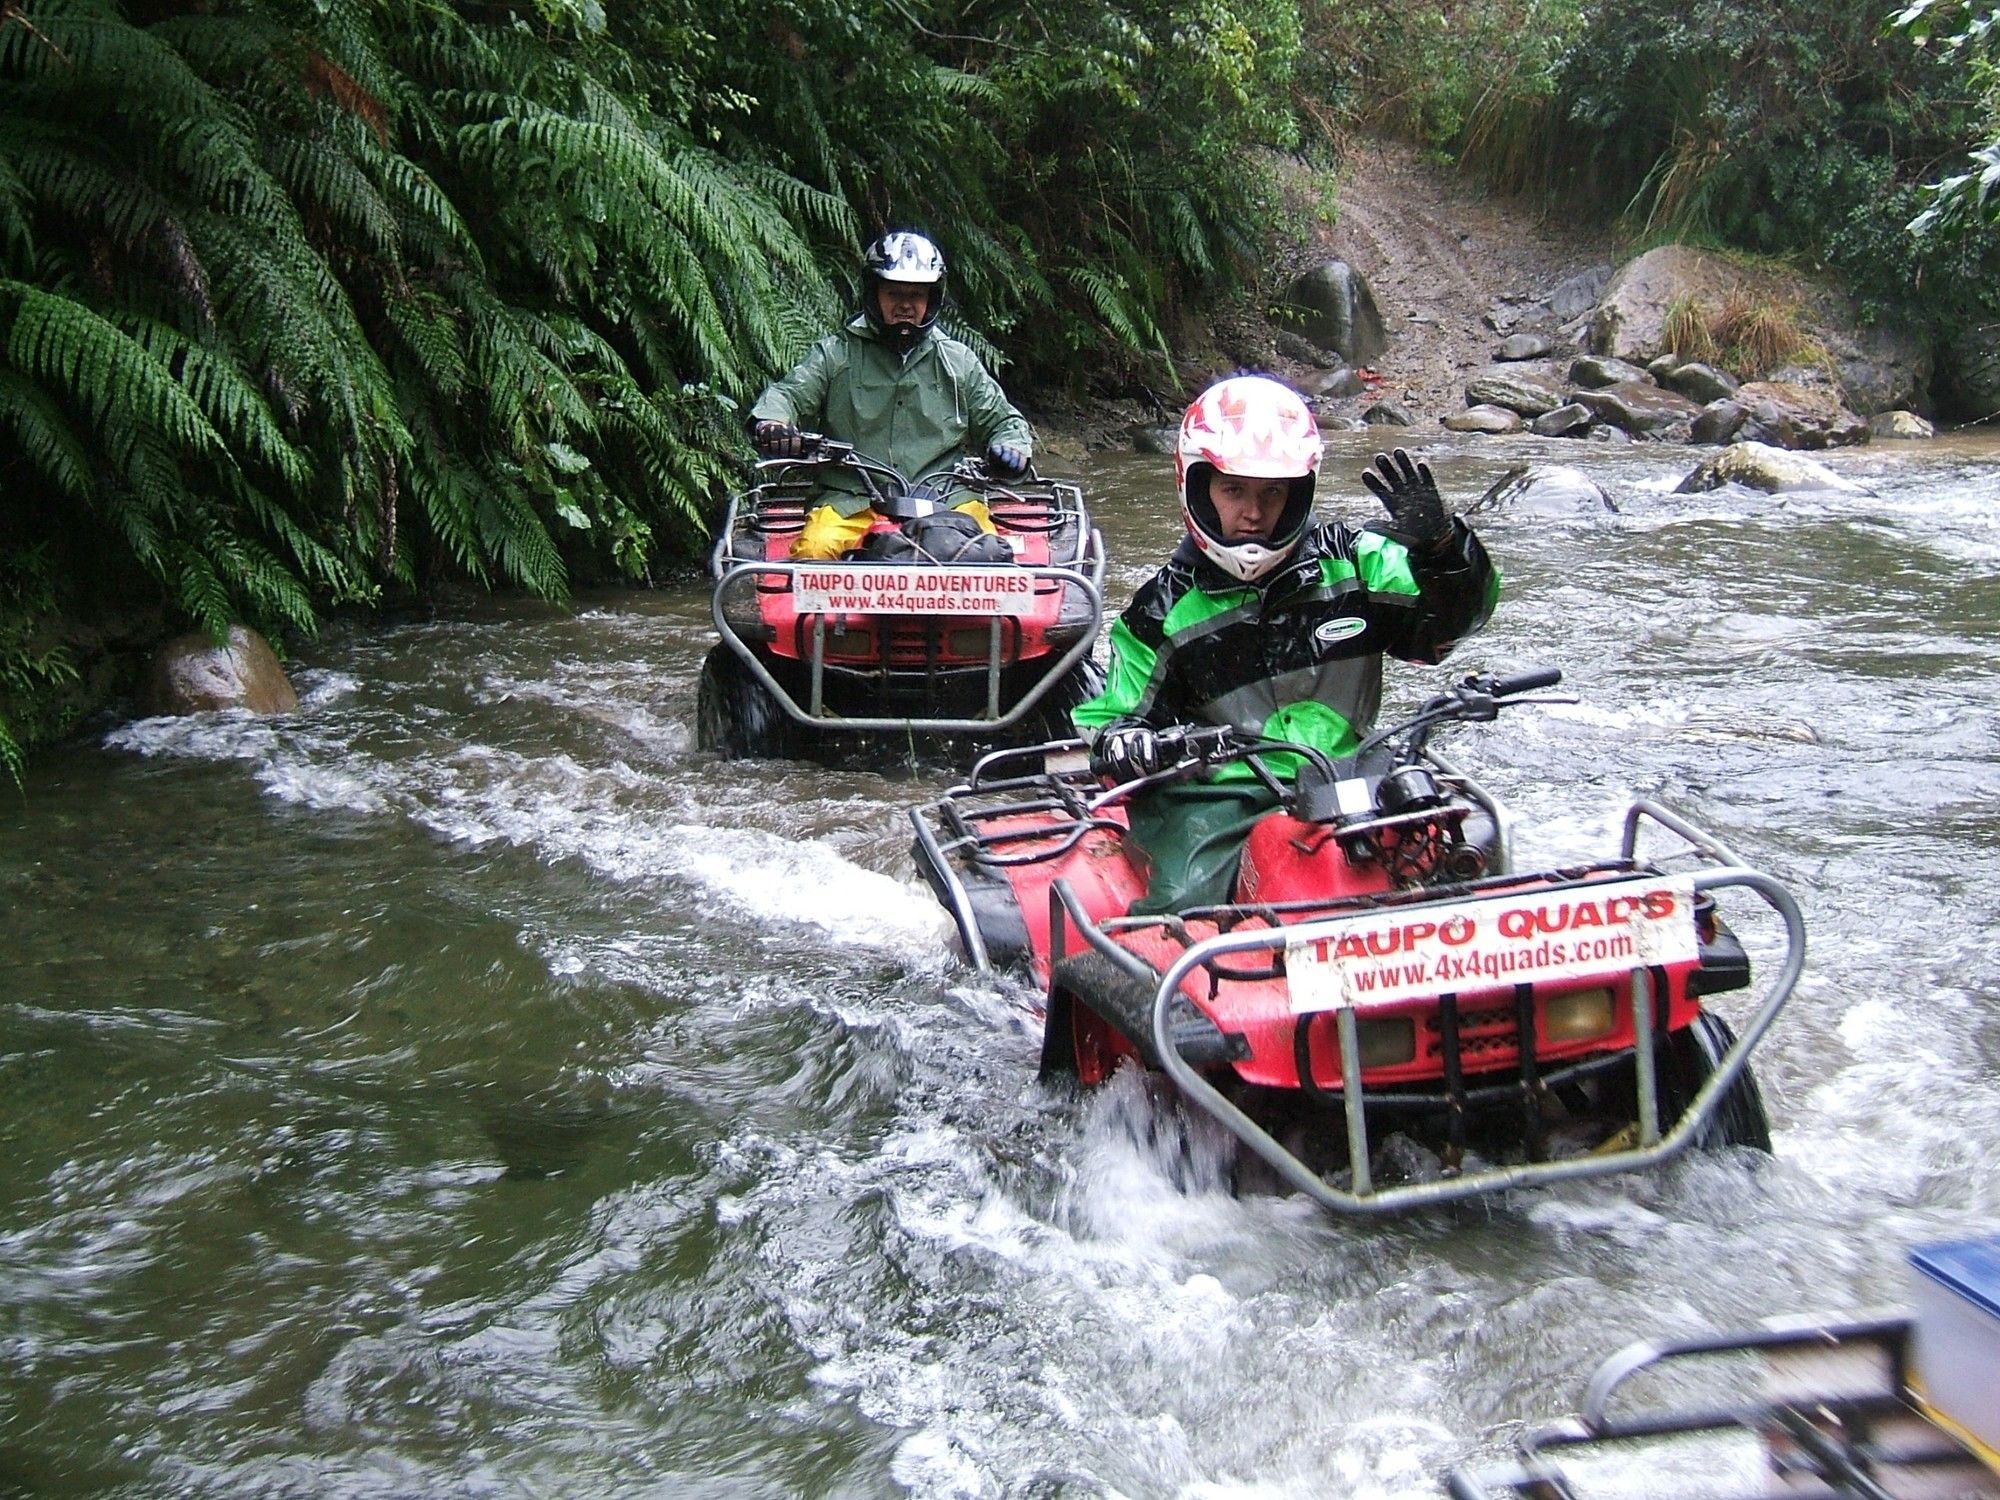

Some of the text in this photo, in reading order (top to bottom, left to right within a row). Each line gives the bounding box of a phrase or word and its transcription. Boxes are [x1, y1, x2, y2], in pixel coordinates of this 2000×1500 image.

[800, 573, 1028, 593] TAUPO QUAD ADVENTURES
[829, 593, 996, 612] www.4x4quads.com
[1307, 890, 1675, 963] TAUPO QUADS
[1354, 933, 1634, 993] www.4x4quads.com
